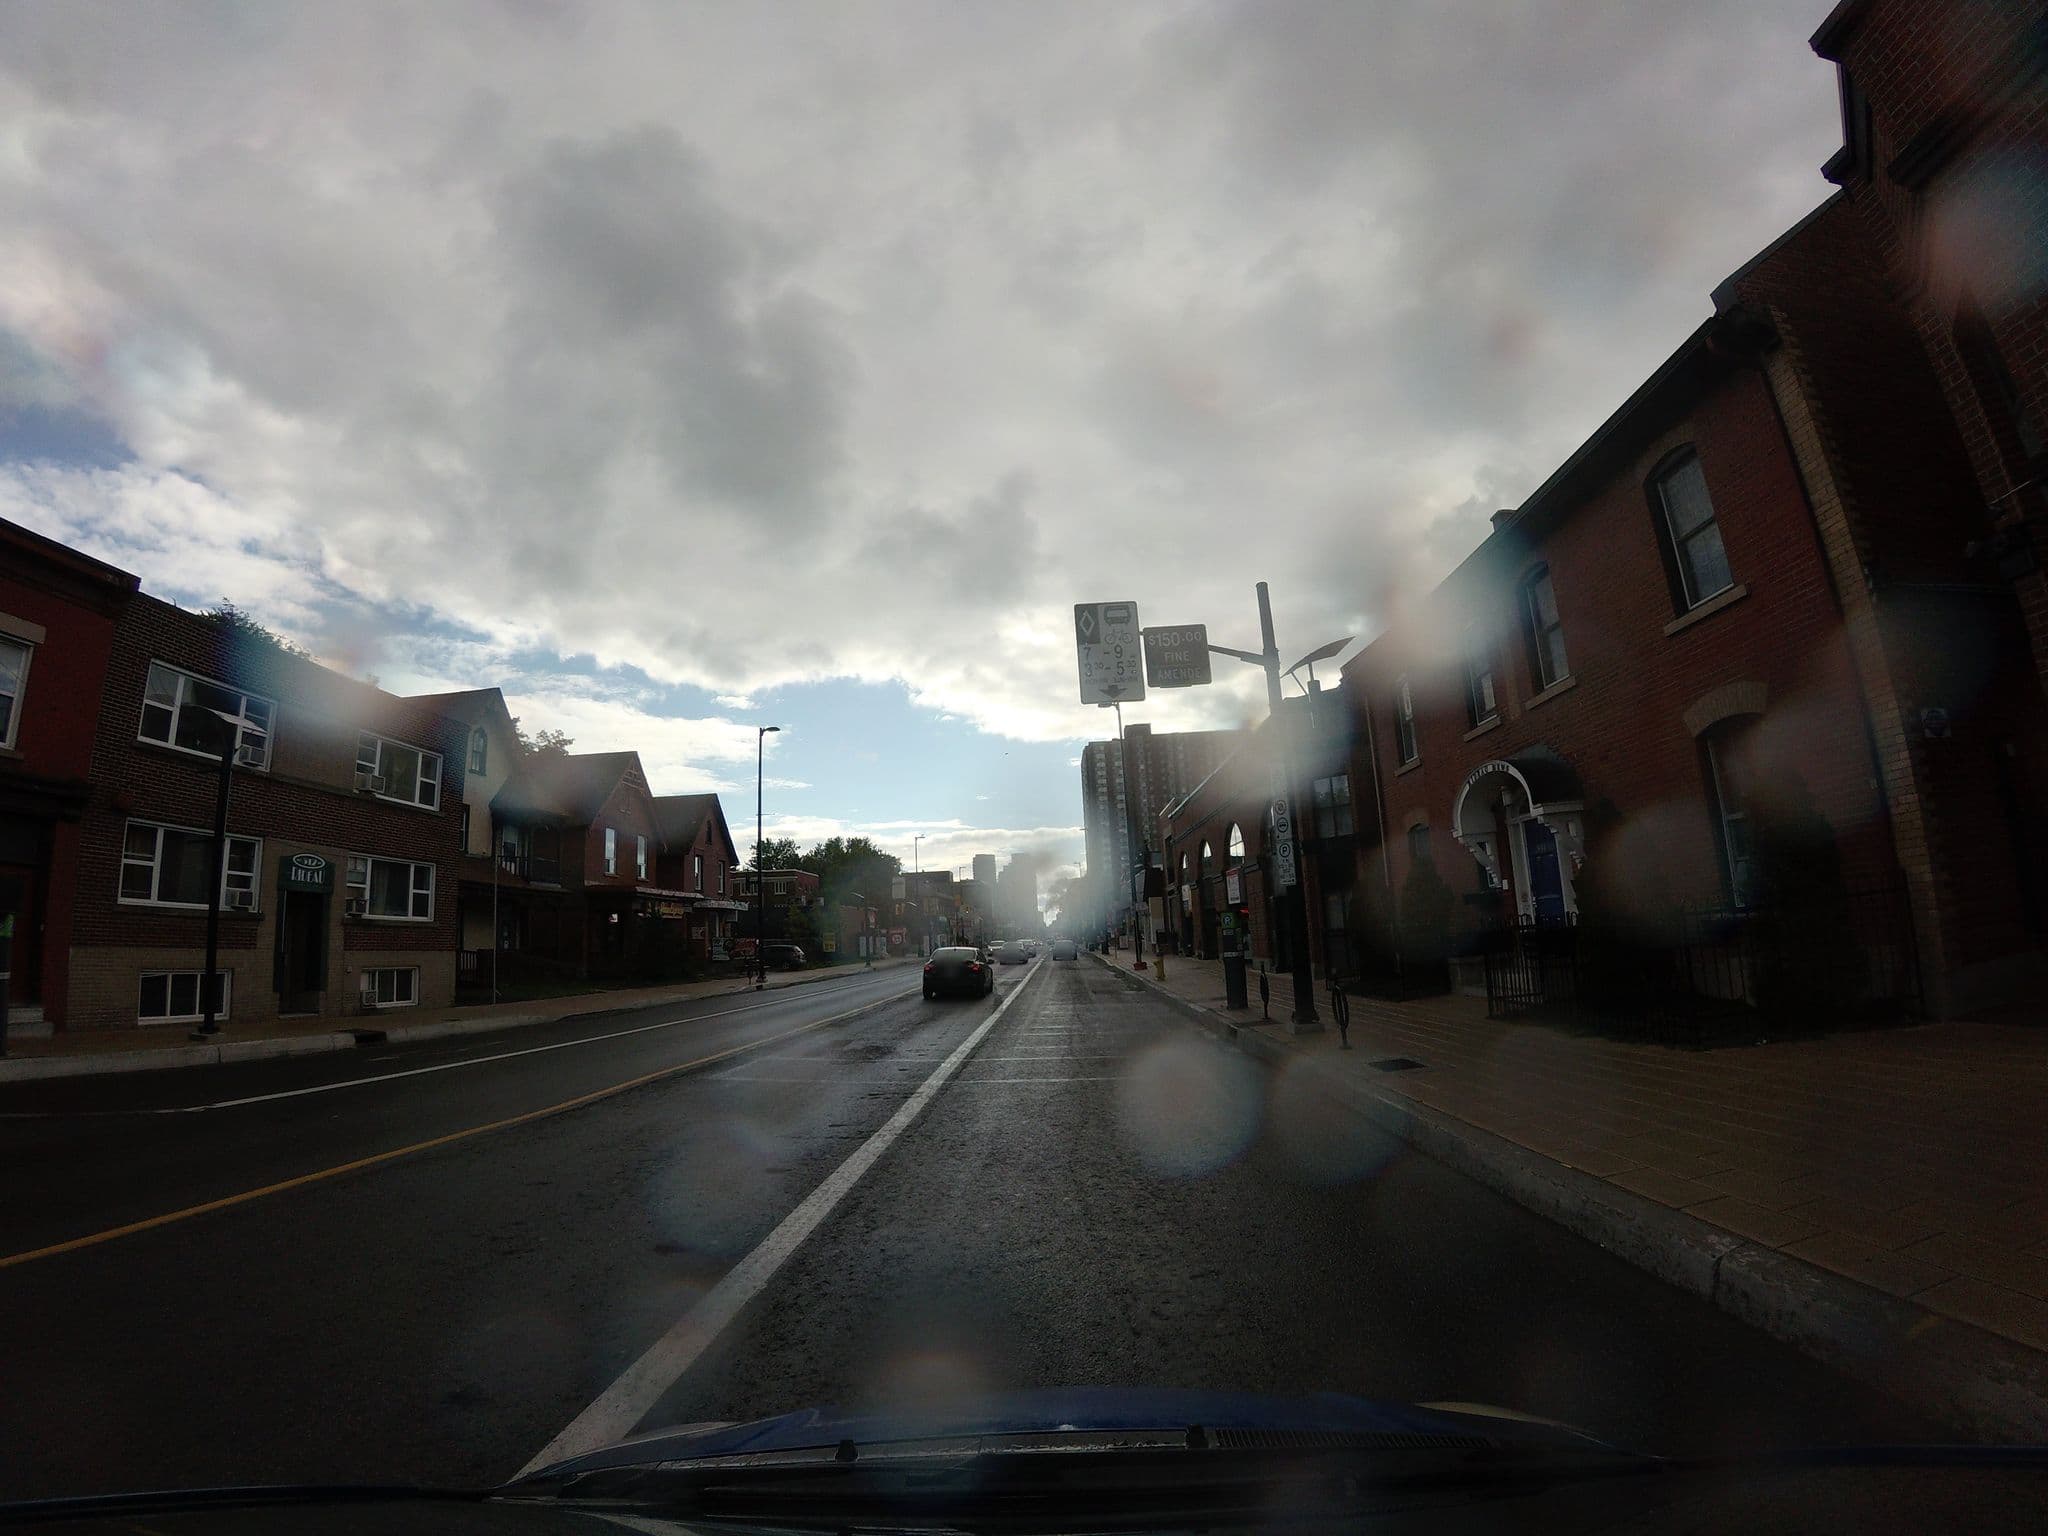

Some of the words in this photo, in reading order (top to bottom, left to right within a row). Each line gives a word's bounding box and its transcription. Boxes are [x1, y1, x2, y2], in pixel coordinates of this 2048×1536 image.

[1148, 631, 1201, 647] $150.00
[1114, 645, 1123, 659] 9
[291, 866, 325, 883] RIDEAU
